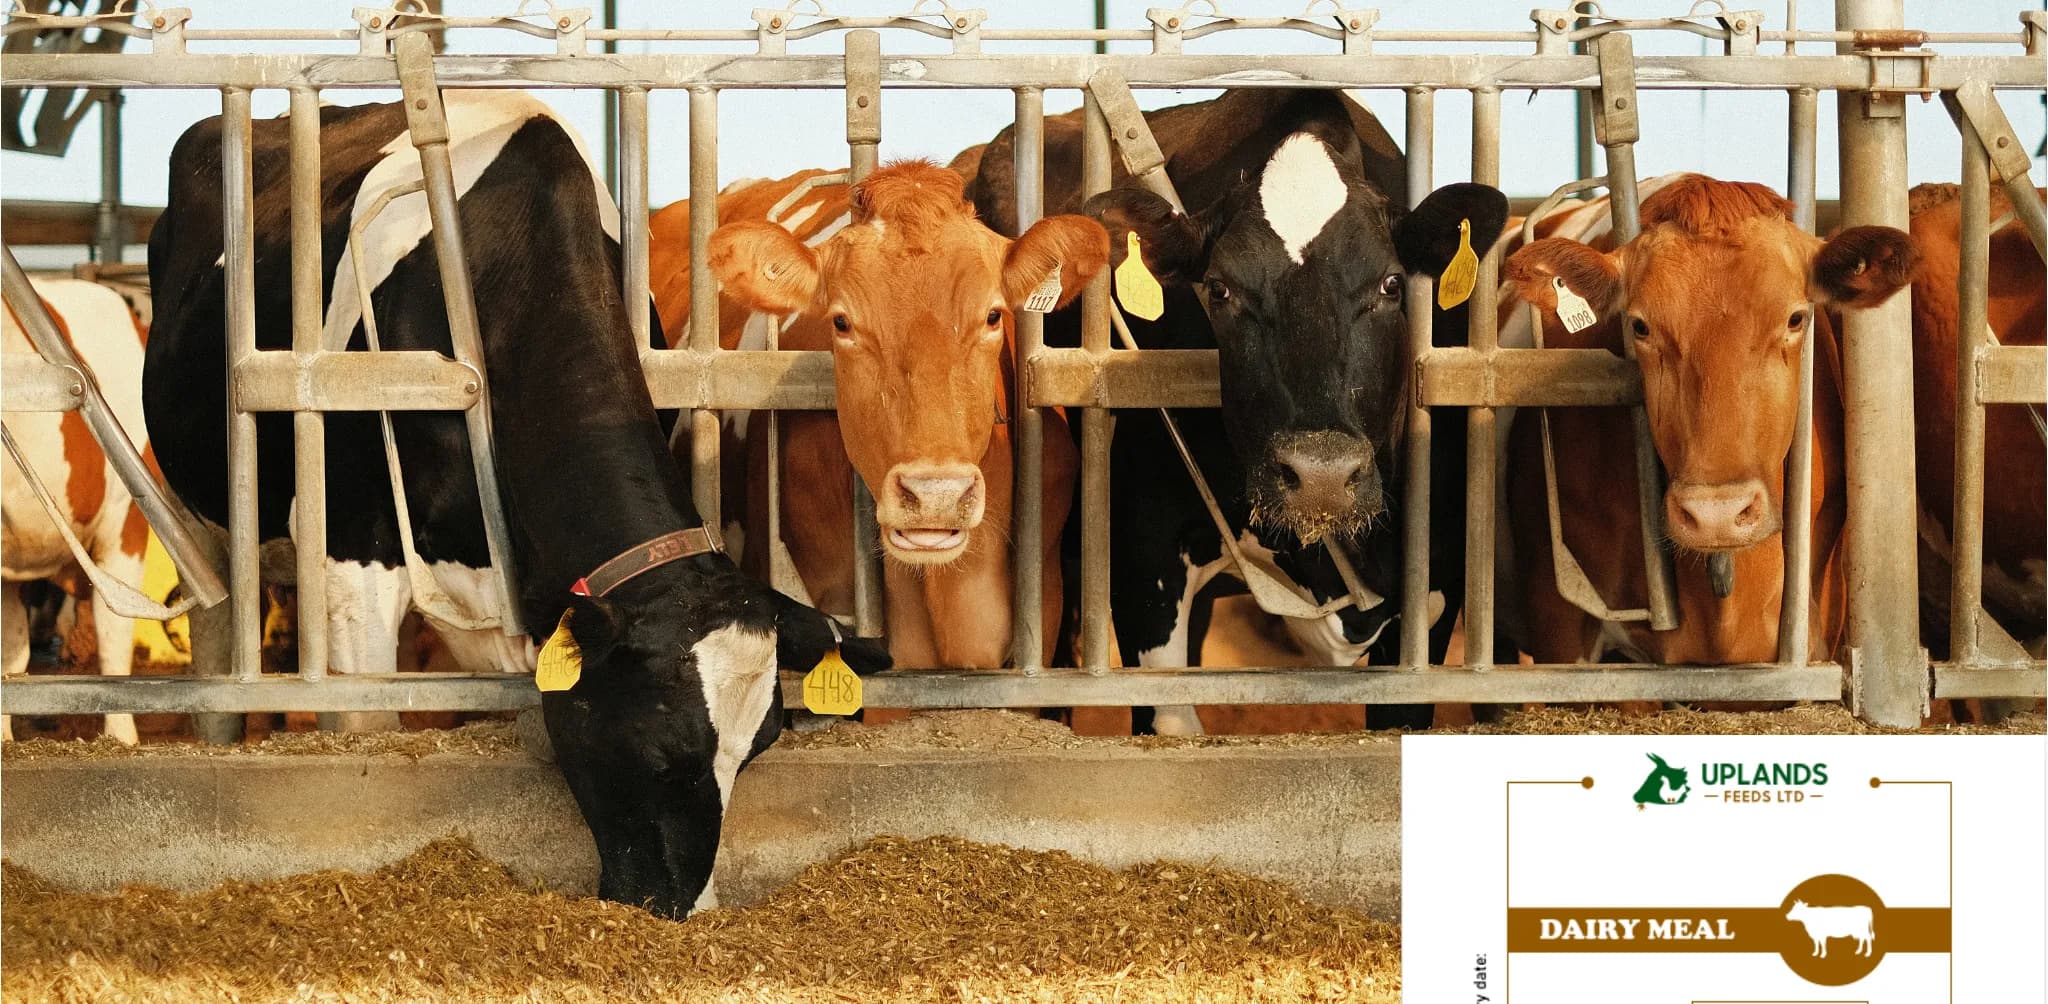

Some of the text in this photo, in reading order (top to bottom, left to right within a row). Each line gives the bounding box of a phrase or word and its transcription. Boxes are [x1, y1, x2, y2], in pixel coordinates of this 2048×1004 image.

[1027, 295, 1054, 311] 1117
[1567, 310, 1593, 331] 1098
[808, 669, 854, 704] 448
